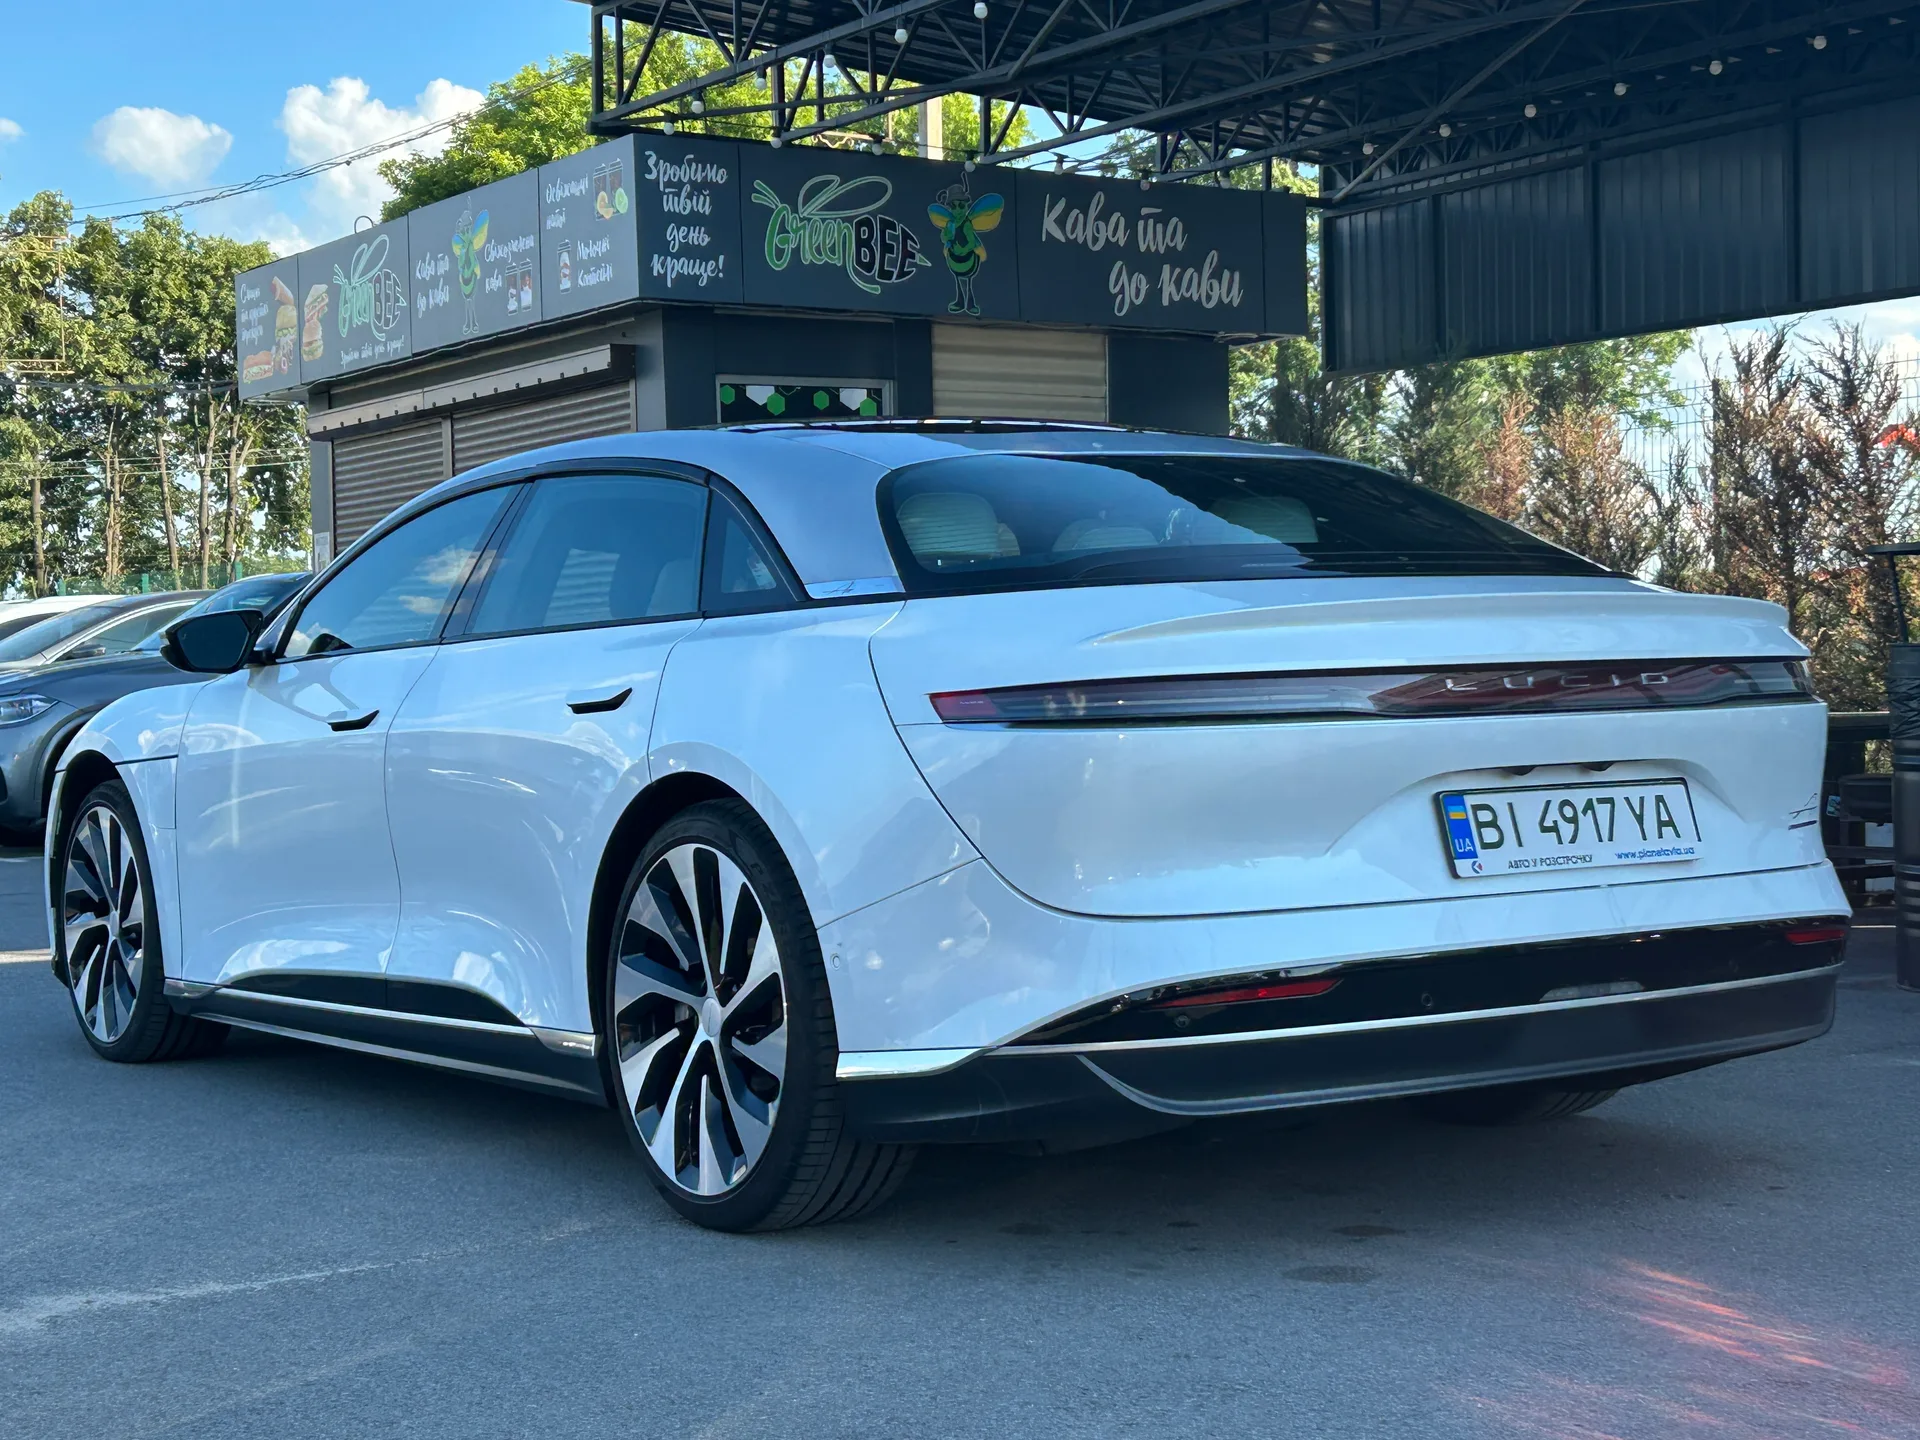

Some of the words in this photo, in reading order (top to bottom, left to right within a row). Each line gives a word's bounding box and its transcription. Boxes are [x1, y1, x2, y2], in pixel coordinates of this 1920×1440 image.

[644, 151, 728, 190] Зробимо
[662, 185, 713, 216] твій
[666, 223, 711, 253] день
[1041, 191, 1130, 251] Кава
[1137, 207, 1188, 254] та
[651, 254, 725, 288] краще!
[1108, 260, 1149, 317] до
[1157, 249, 1244, 309] кави
[1445, 672, 1669, 691] LUCID
[1470, 802, 1524, 850] BI
[1537, 796, 1616, 845] 4917
[1454, 838, 1474, 853] UA
